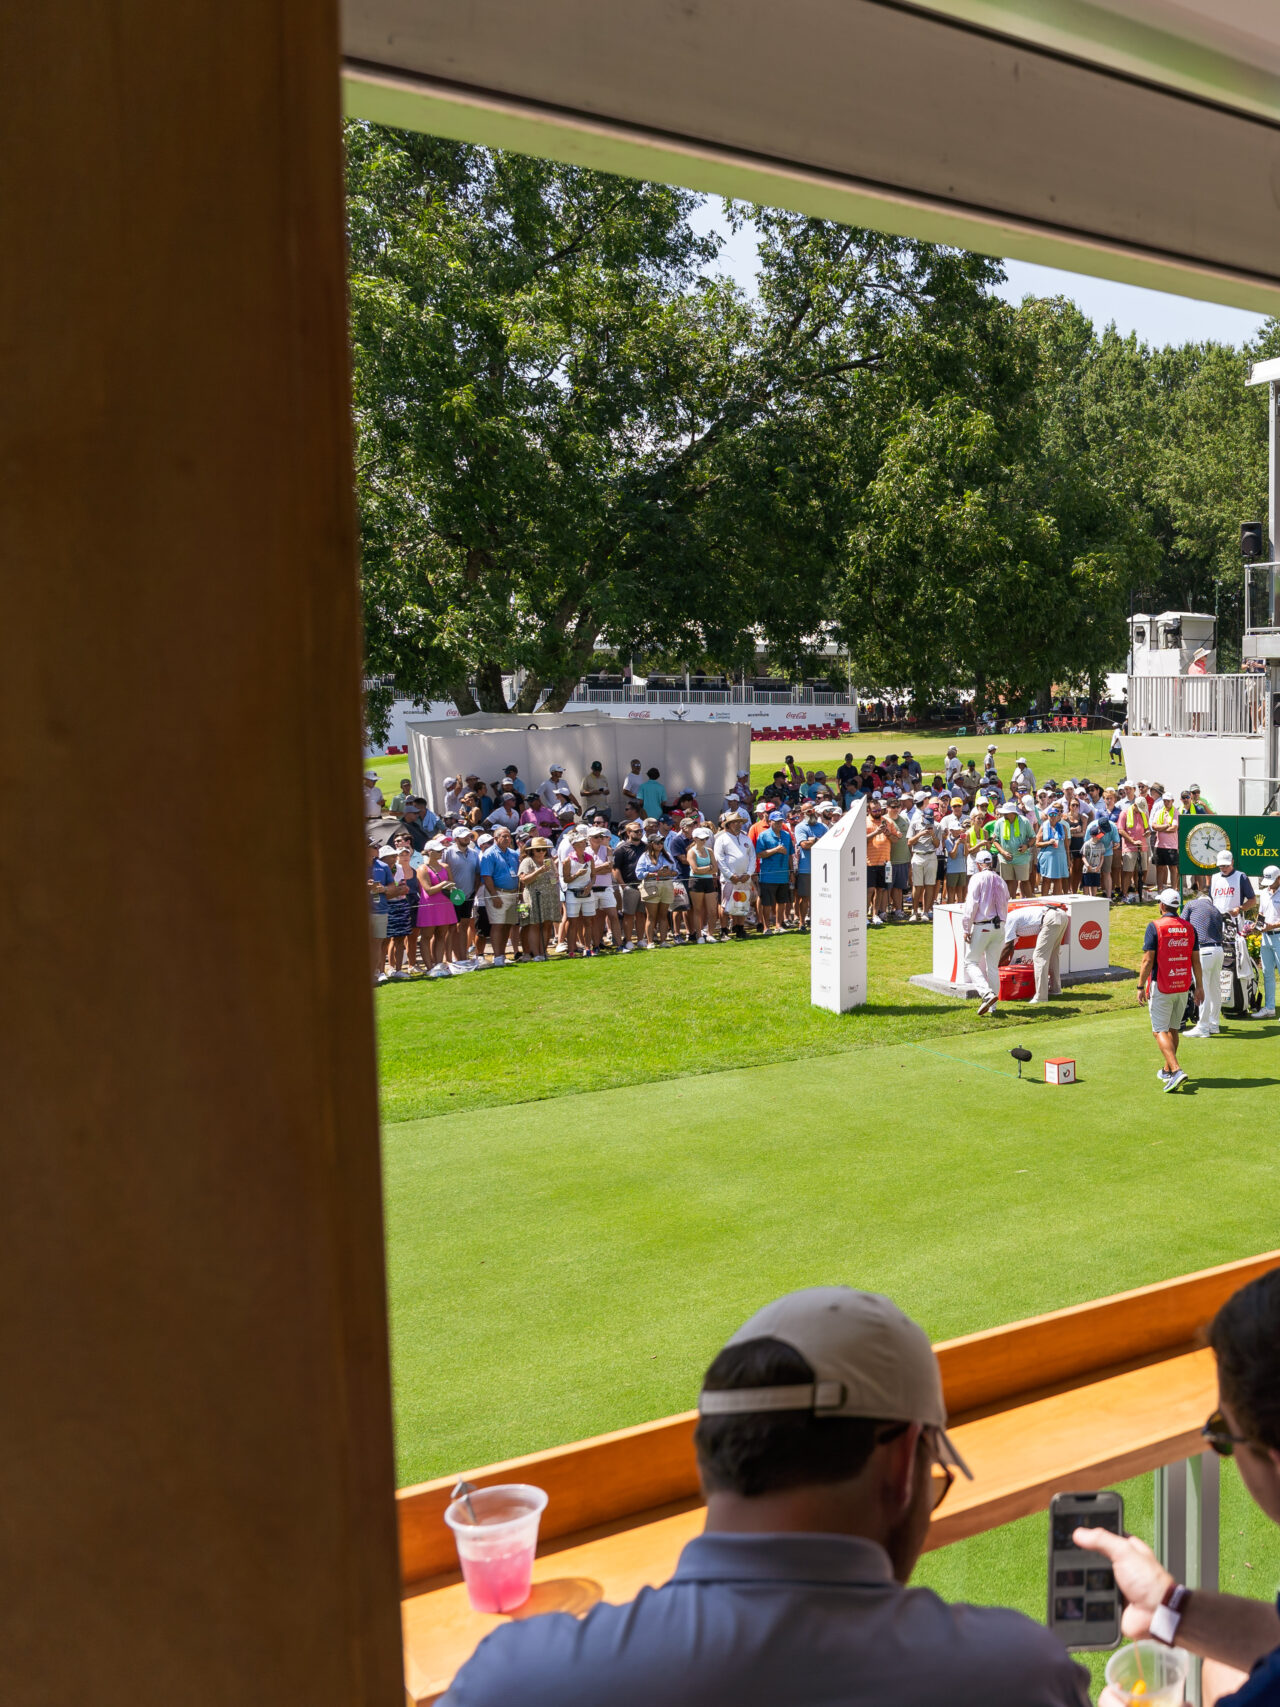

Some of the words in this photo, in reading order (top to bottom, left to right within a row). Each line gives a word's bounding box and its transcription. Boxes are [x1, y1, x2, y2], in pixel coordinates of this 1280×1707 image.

[785, 711, 807, 720] Coca-Cola
[851, 846, 856, 867] 1
[1241, 848, 1279, 857] ROLEX
[823, 863, 828, 883] 1
[1214, 887, 1235, 897] TOUR
[1079, 930, 1101, 941] Coca-Cola
[1167, 937, 1189, 948] Coca-Cola
